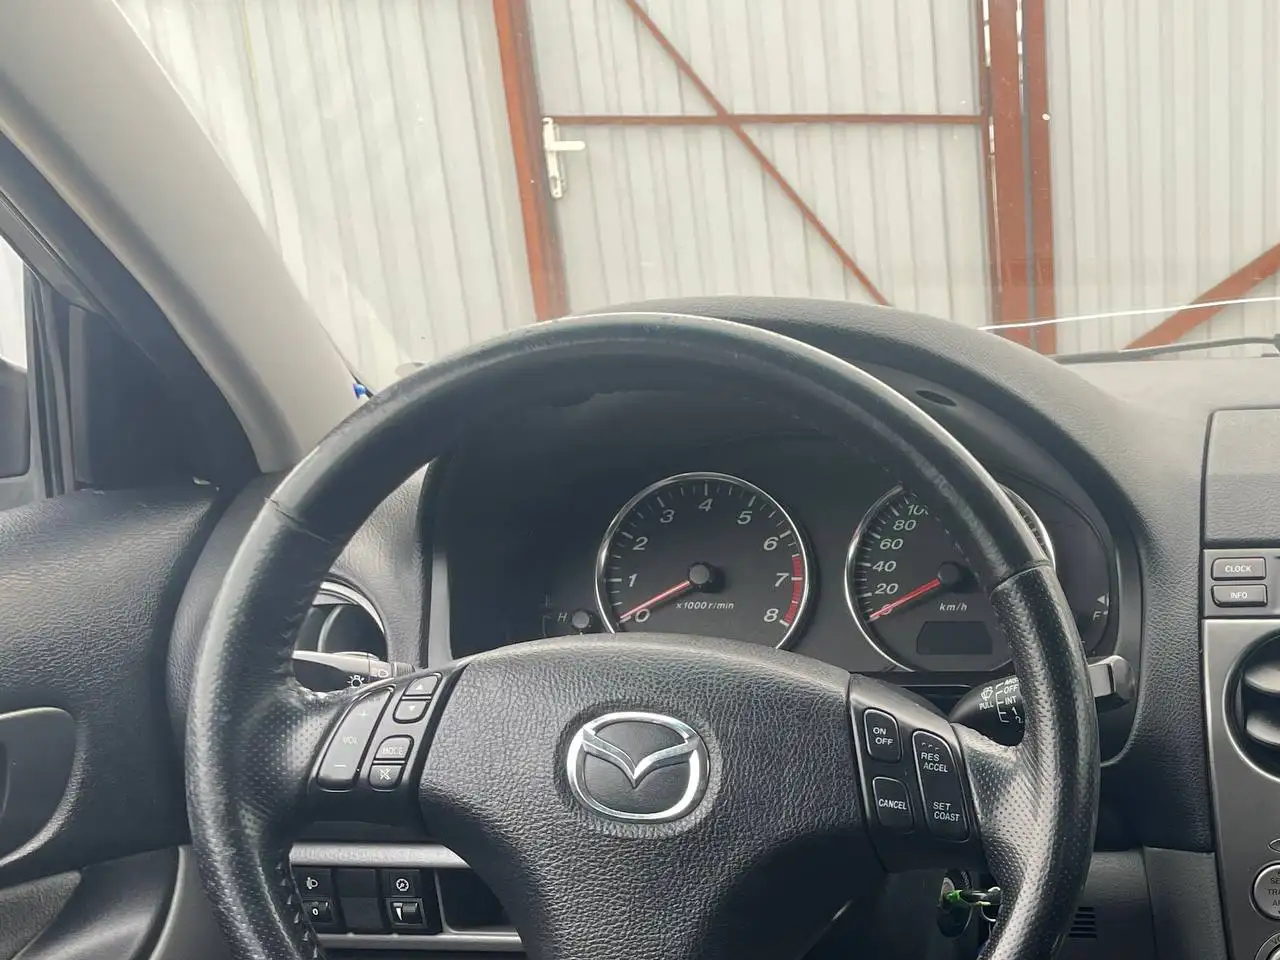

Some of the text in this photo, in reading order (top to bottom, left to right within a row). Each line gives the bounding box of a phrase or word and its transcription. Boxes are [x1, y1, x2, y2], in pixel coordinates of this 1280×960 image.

[698, 498, 713, 512] 4
[660, 509, 675, 523] 3
[737, 511, 752, 524] 5
[893, 520, 916, 531] 80
[633, 536, 648, 550] 2
[763, 536, 778, 550] 6
[879, 538, 904, 550] 60
[872, 561, 896, 572] 40
[1225, 565, 1252, 573] CLOCK
[628, 574, 638, 587] 1
[774, 573, 789, 587] 7
[875, 583, 899, 595] 20
[939, 603, 967, 611] km/h
[557, 612, 568, 622] H
[634, 609, 651, 623] 0
[763, 608, 778, 622] 8
[1004, 684, 1018, 694] OFF
[979, 701, 994, 710] PULL
[1005, 696, 1017, 705] INT
[872, 727, 887, 735] ON
[875, 737, 894, 746] OFF
[920, 752, 940, 762] RES
[923, 762, 949, 773] ACCEL
[878, 798, 908, 810] CANCEL
[933, 801, 951, 811] SET
[933, 811, 960, 822] COAST
